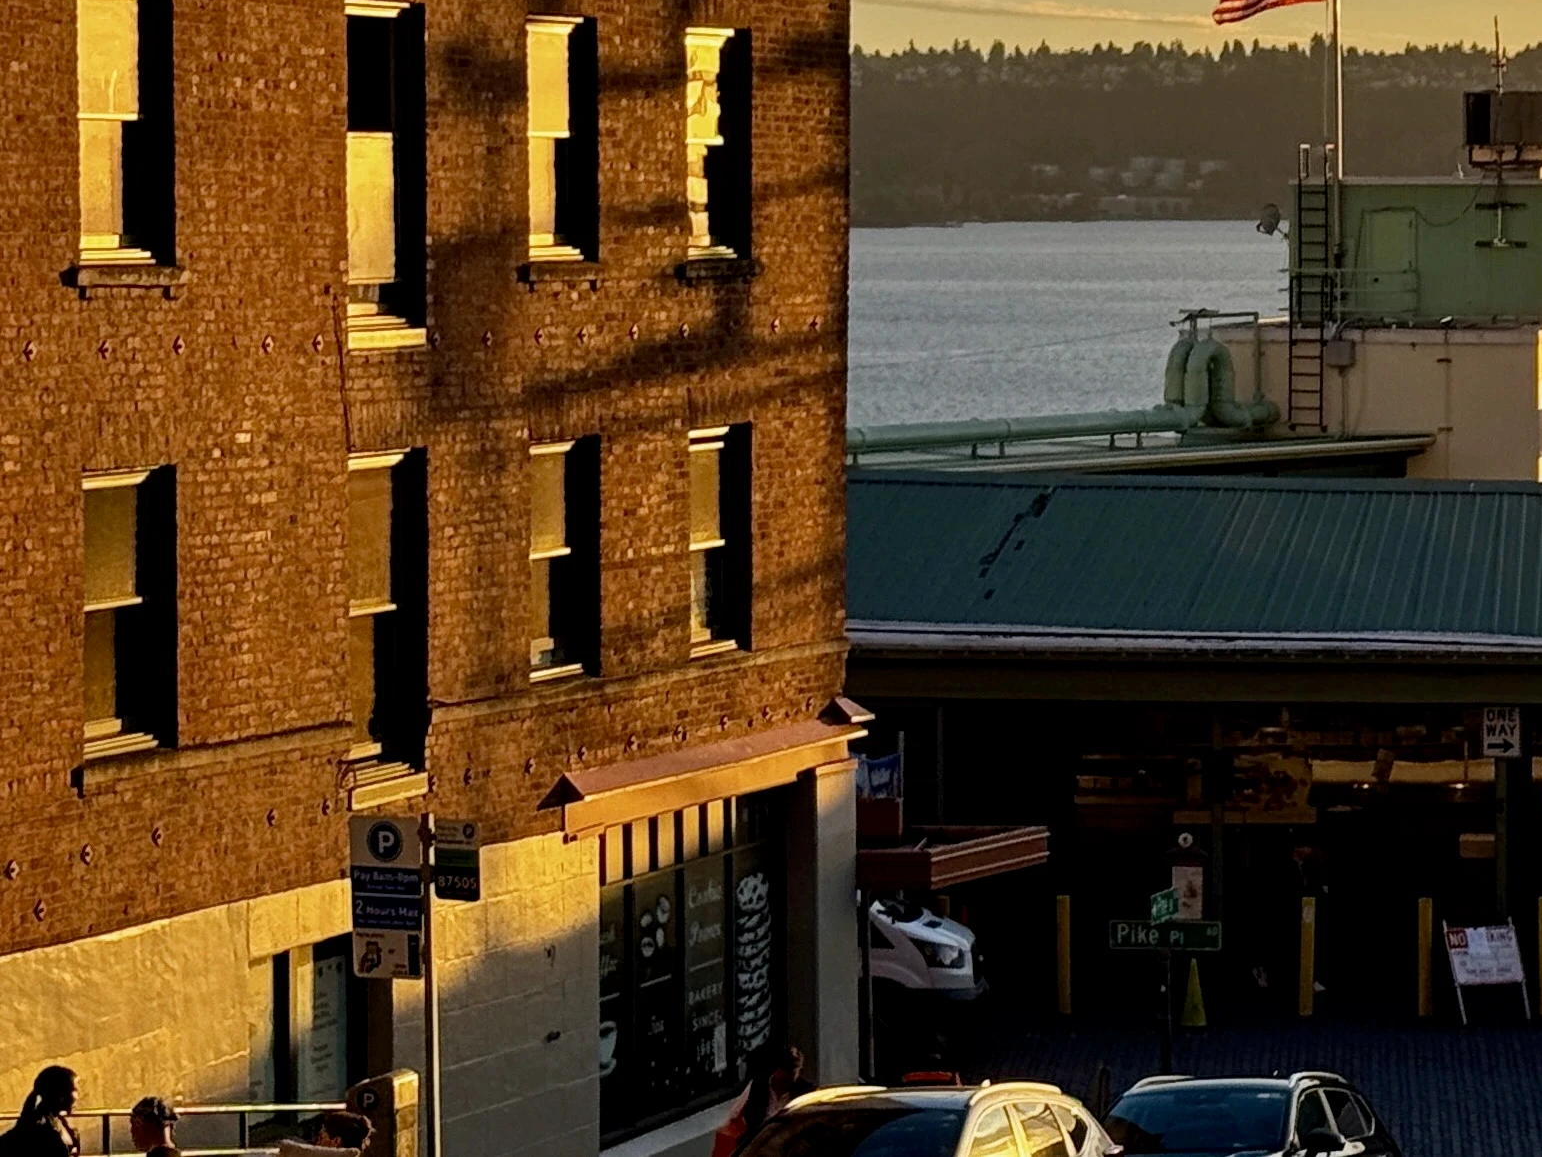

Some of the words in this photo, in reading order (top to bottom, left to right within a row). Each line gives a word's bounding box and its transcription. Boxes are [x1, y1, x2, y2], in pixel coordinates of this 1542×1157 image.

[1486, 708, 1517, 722] ONE
[1486, 724, 1517, 737] WAY
[377, 830, 395, 854] P
[353, 869, 371, 884] Pay
[437, 876, 477, 890] 87505
[355, 899, 364, 916] 2
[366, 906, 396, 918] Hours
[398, 907, 419, 918] Max
[1117, 923, 1160, 945] Pike
[1169, 929, 1184, 946] Pl
[1449, 931, 1466, 946] NO
[362, 1093, 375, 1109] P
